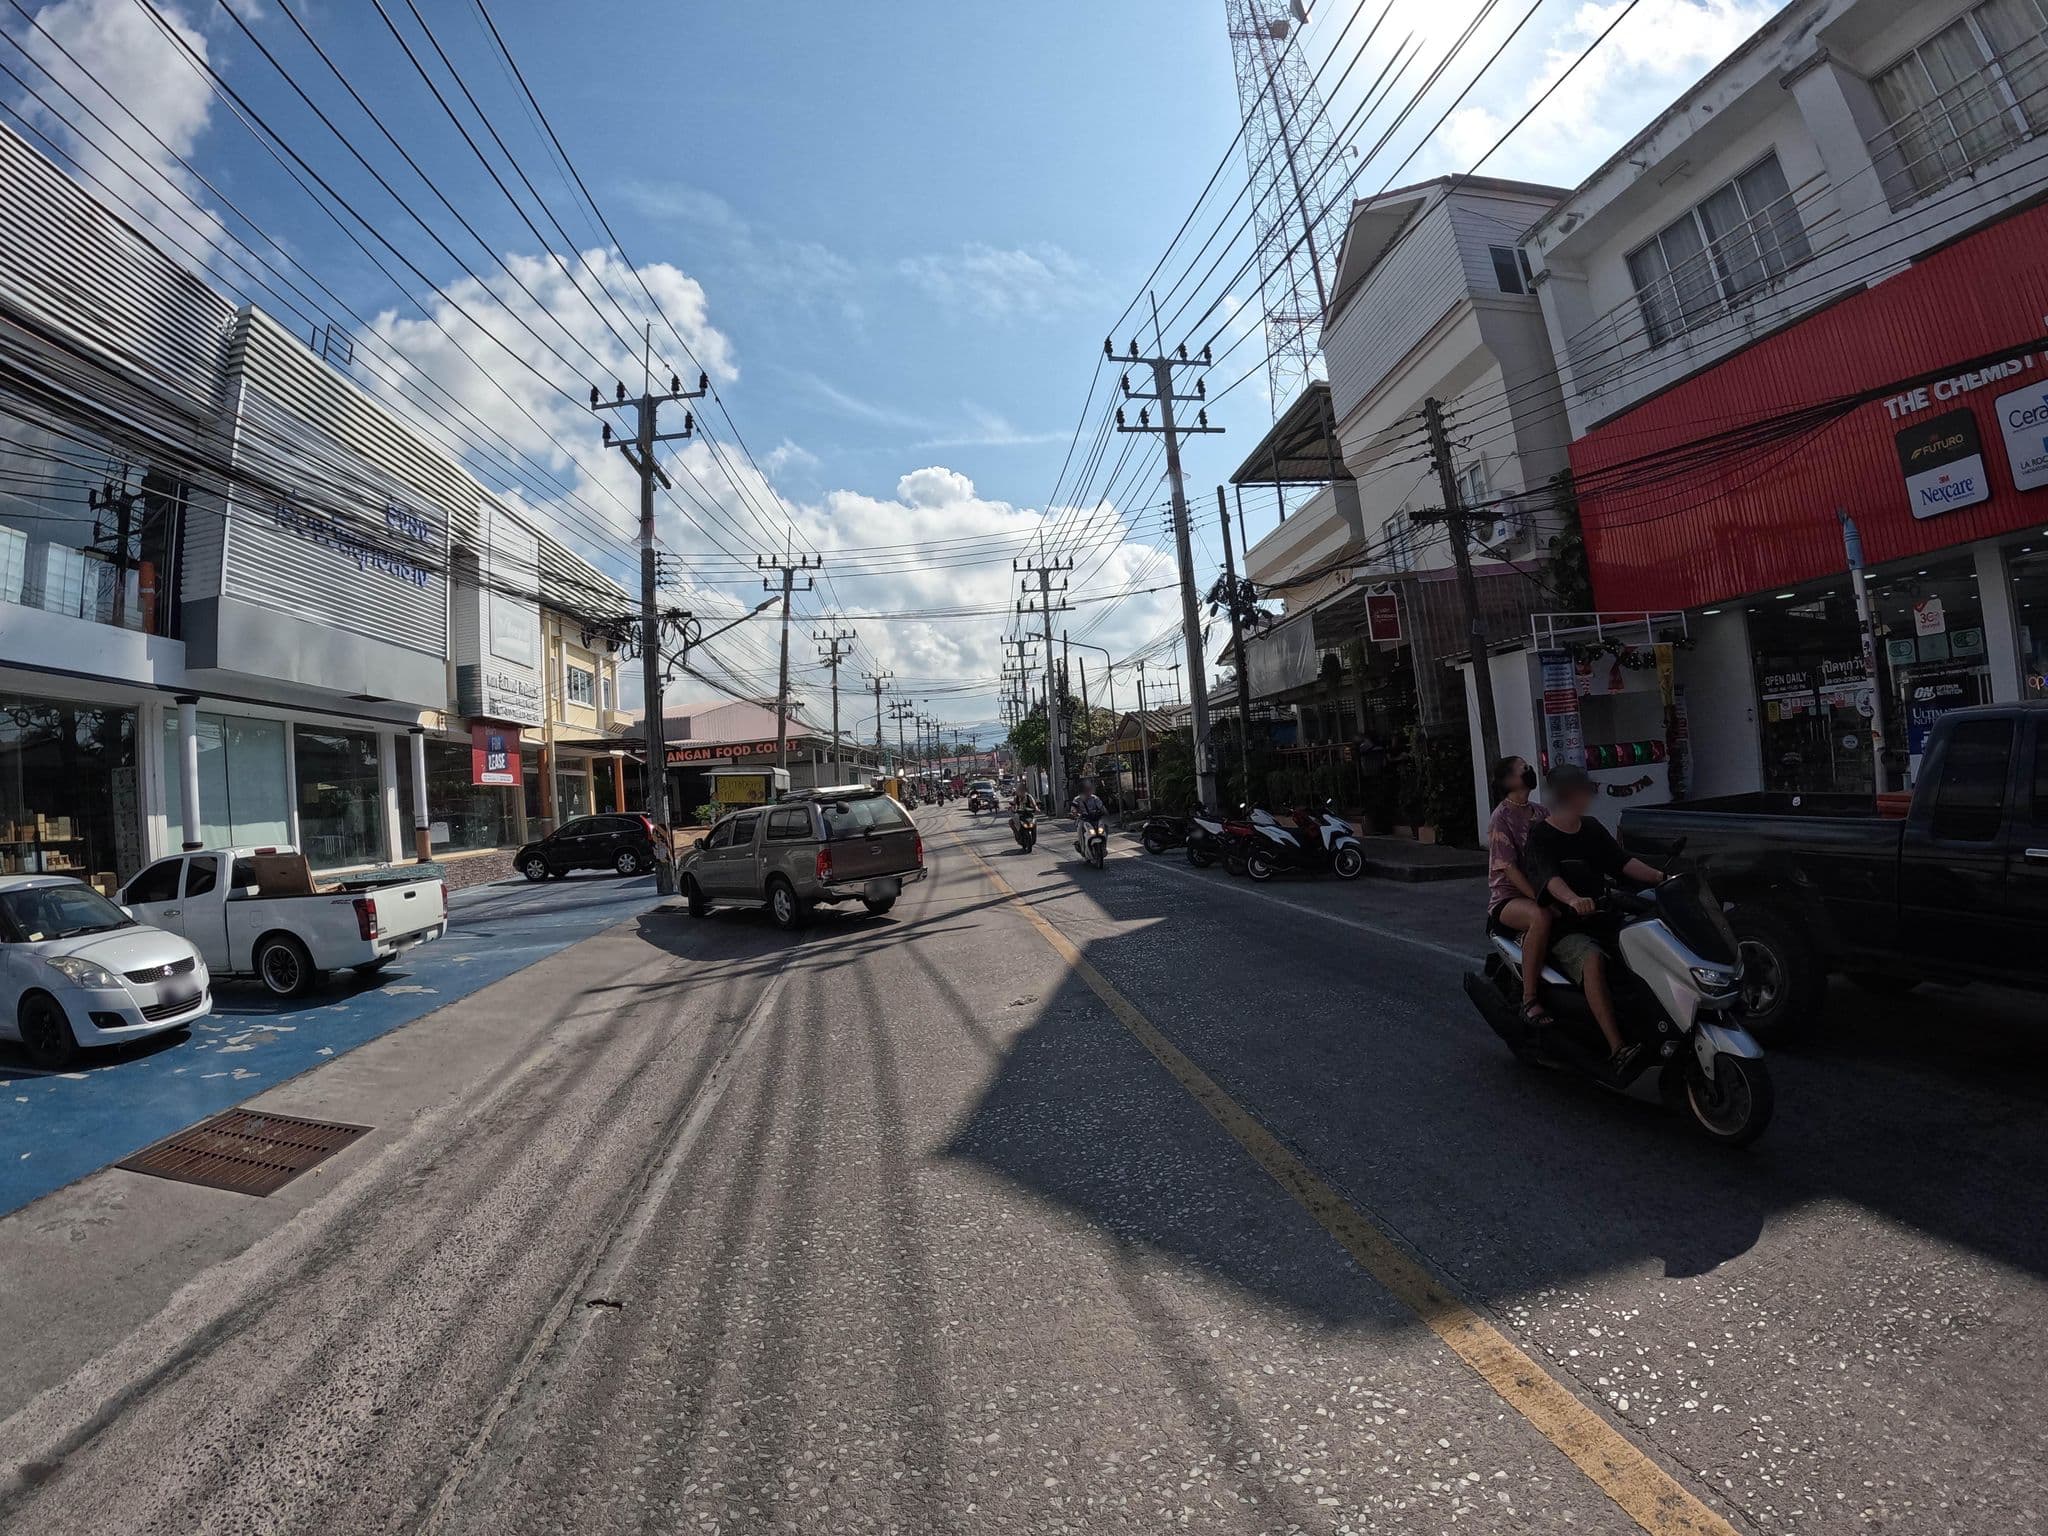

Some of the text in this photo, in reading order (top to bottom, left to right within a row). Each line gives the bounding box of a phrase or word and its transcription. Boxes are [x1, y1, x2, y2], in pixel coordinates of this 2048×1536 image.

[1884, 387, 1930, 420] THE
[1922, 433, 1964, 456] FUTURO
[1938, 475, 1950, 484] 3M
[1920, 478, 1975, 506] Nexcare
[1765, 671, 1807, 687] OPEN DAILY
[716, 744, 751, 758] FOOD
[488, 753, 506, 770] LEASE
